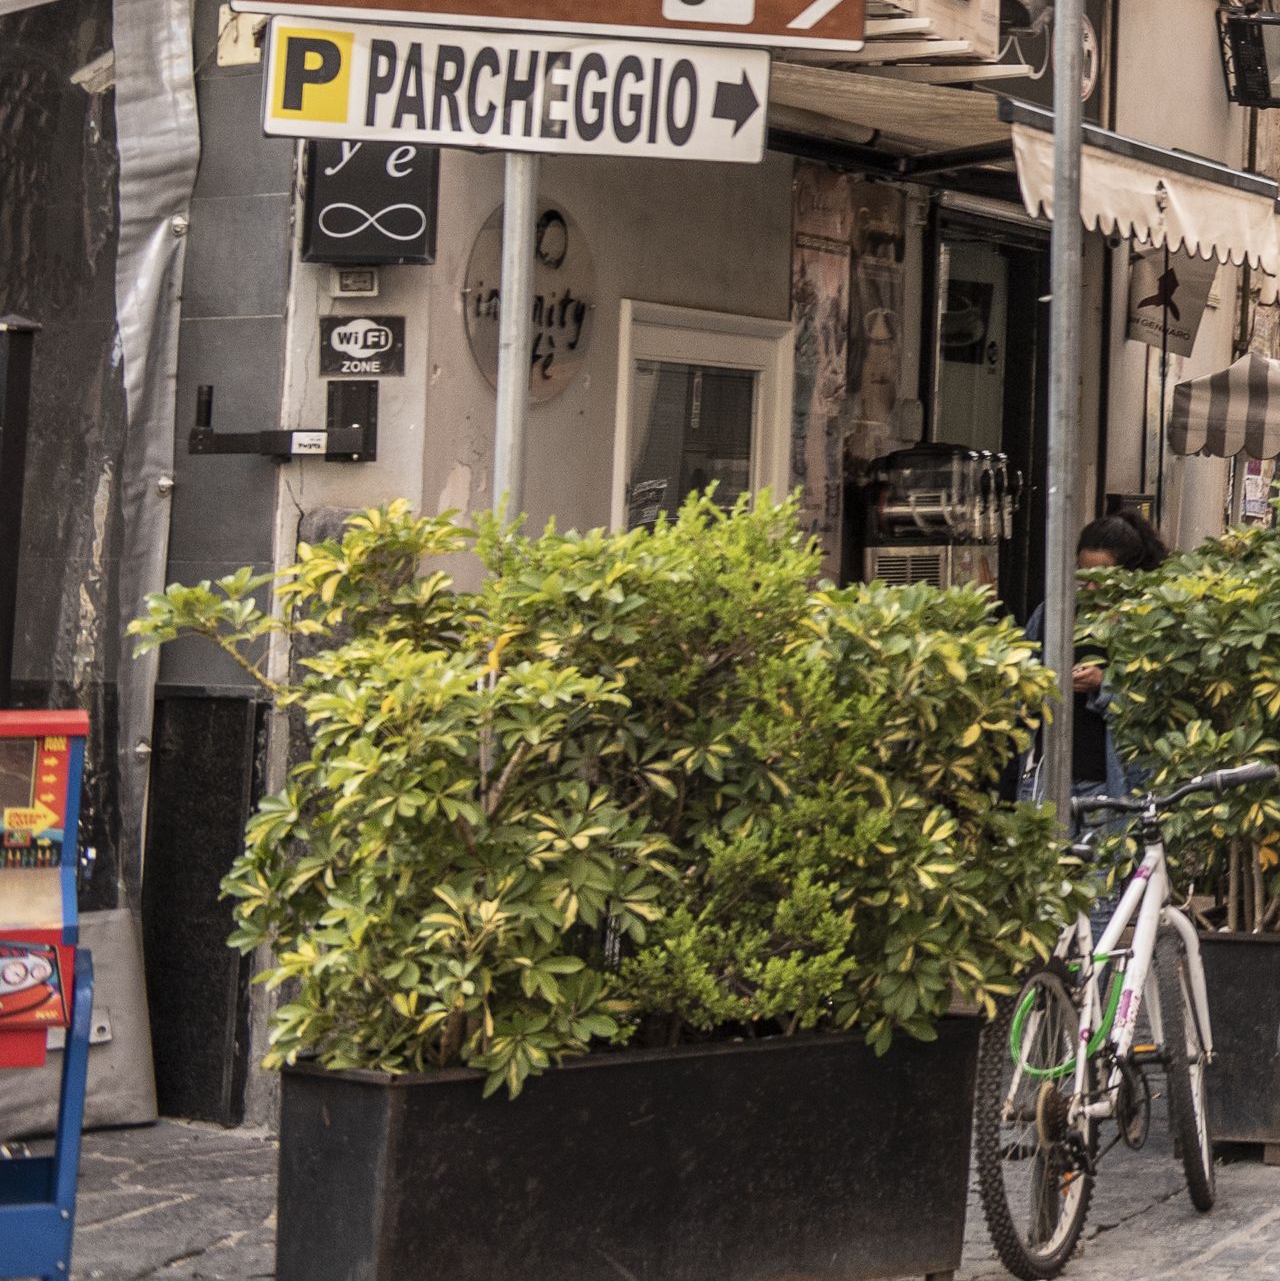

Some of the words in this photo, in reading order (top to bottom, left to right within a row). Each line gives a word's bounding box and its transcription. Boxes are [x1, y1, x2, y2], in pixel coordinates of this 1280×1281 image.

[280, 37, 342, 112] P
[364, 38, 699, 147] PARCHEGGIO
[338, 331, 386, 345] WiFi
[341, 360, 380, 373] ZONE
